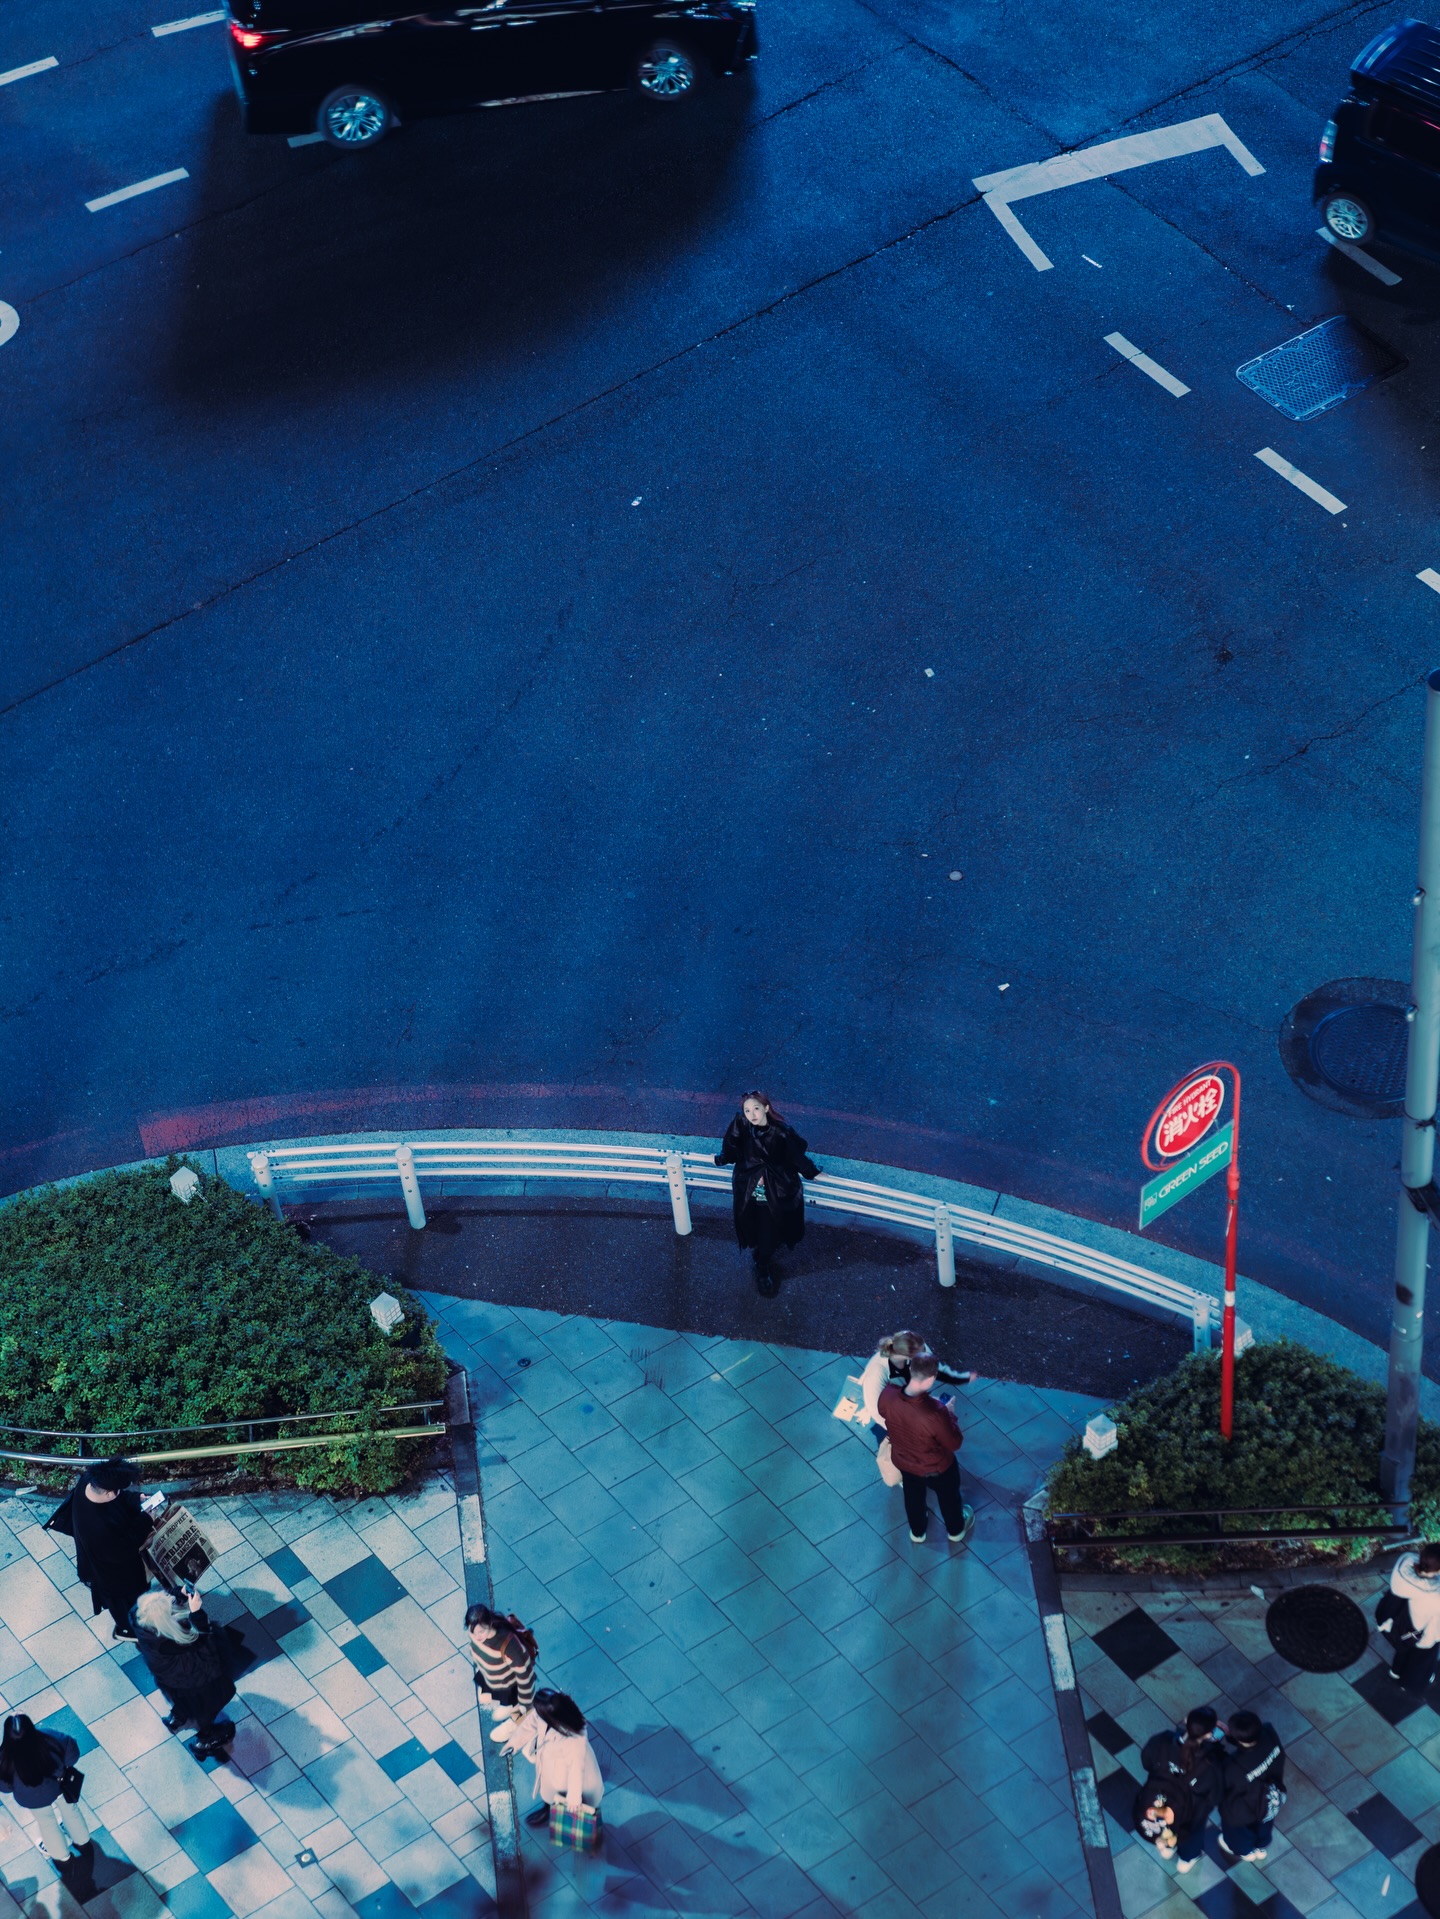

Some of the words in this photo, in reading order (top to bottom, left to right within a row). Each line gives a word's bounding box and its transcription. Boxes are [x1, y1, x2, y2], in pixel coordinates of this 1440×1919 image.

[1164, 1088, 1218, 1147] 消火栓
[1168, 1102, 1183, 1117] FIRE
[1183, 1080, 1211, 1105] HYDRANT
[1159, 1163, 1197, 1198] GREEN
[1199, 1142, 1228, 1170] SEED
[165, 1512, 189, 1537] PROPHET
